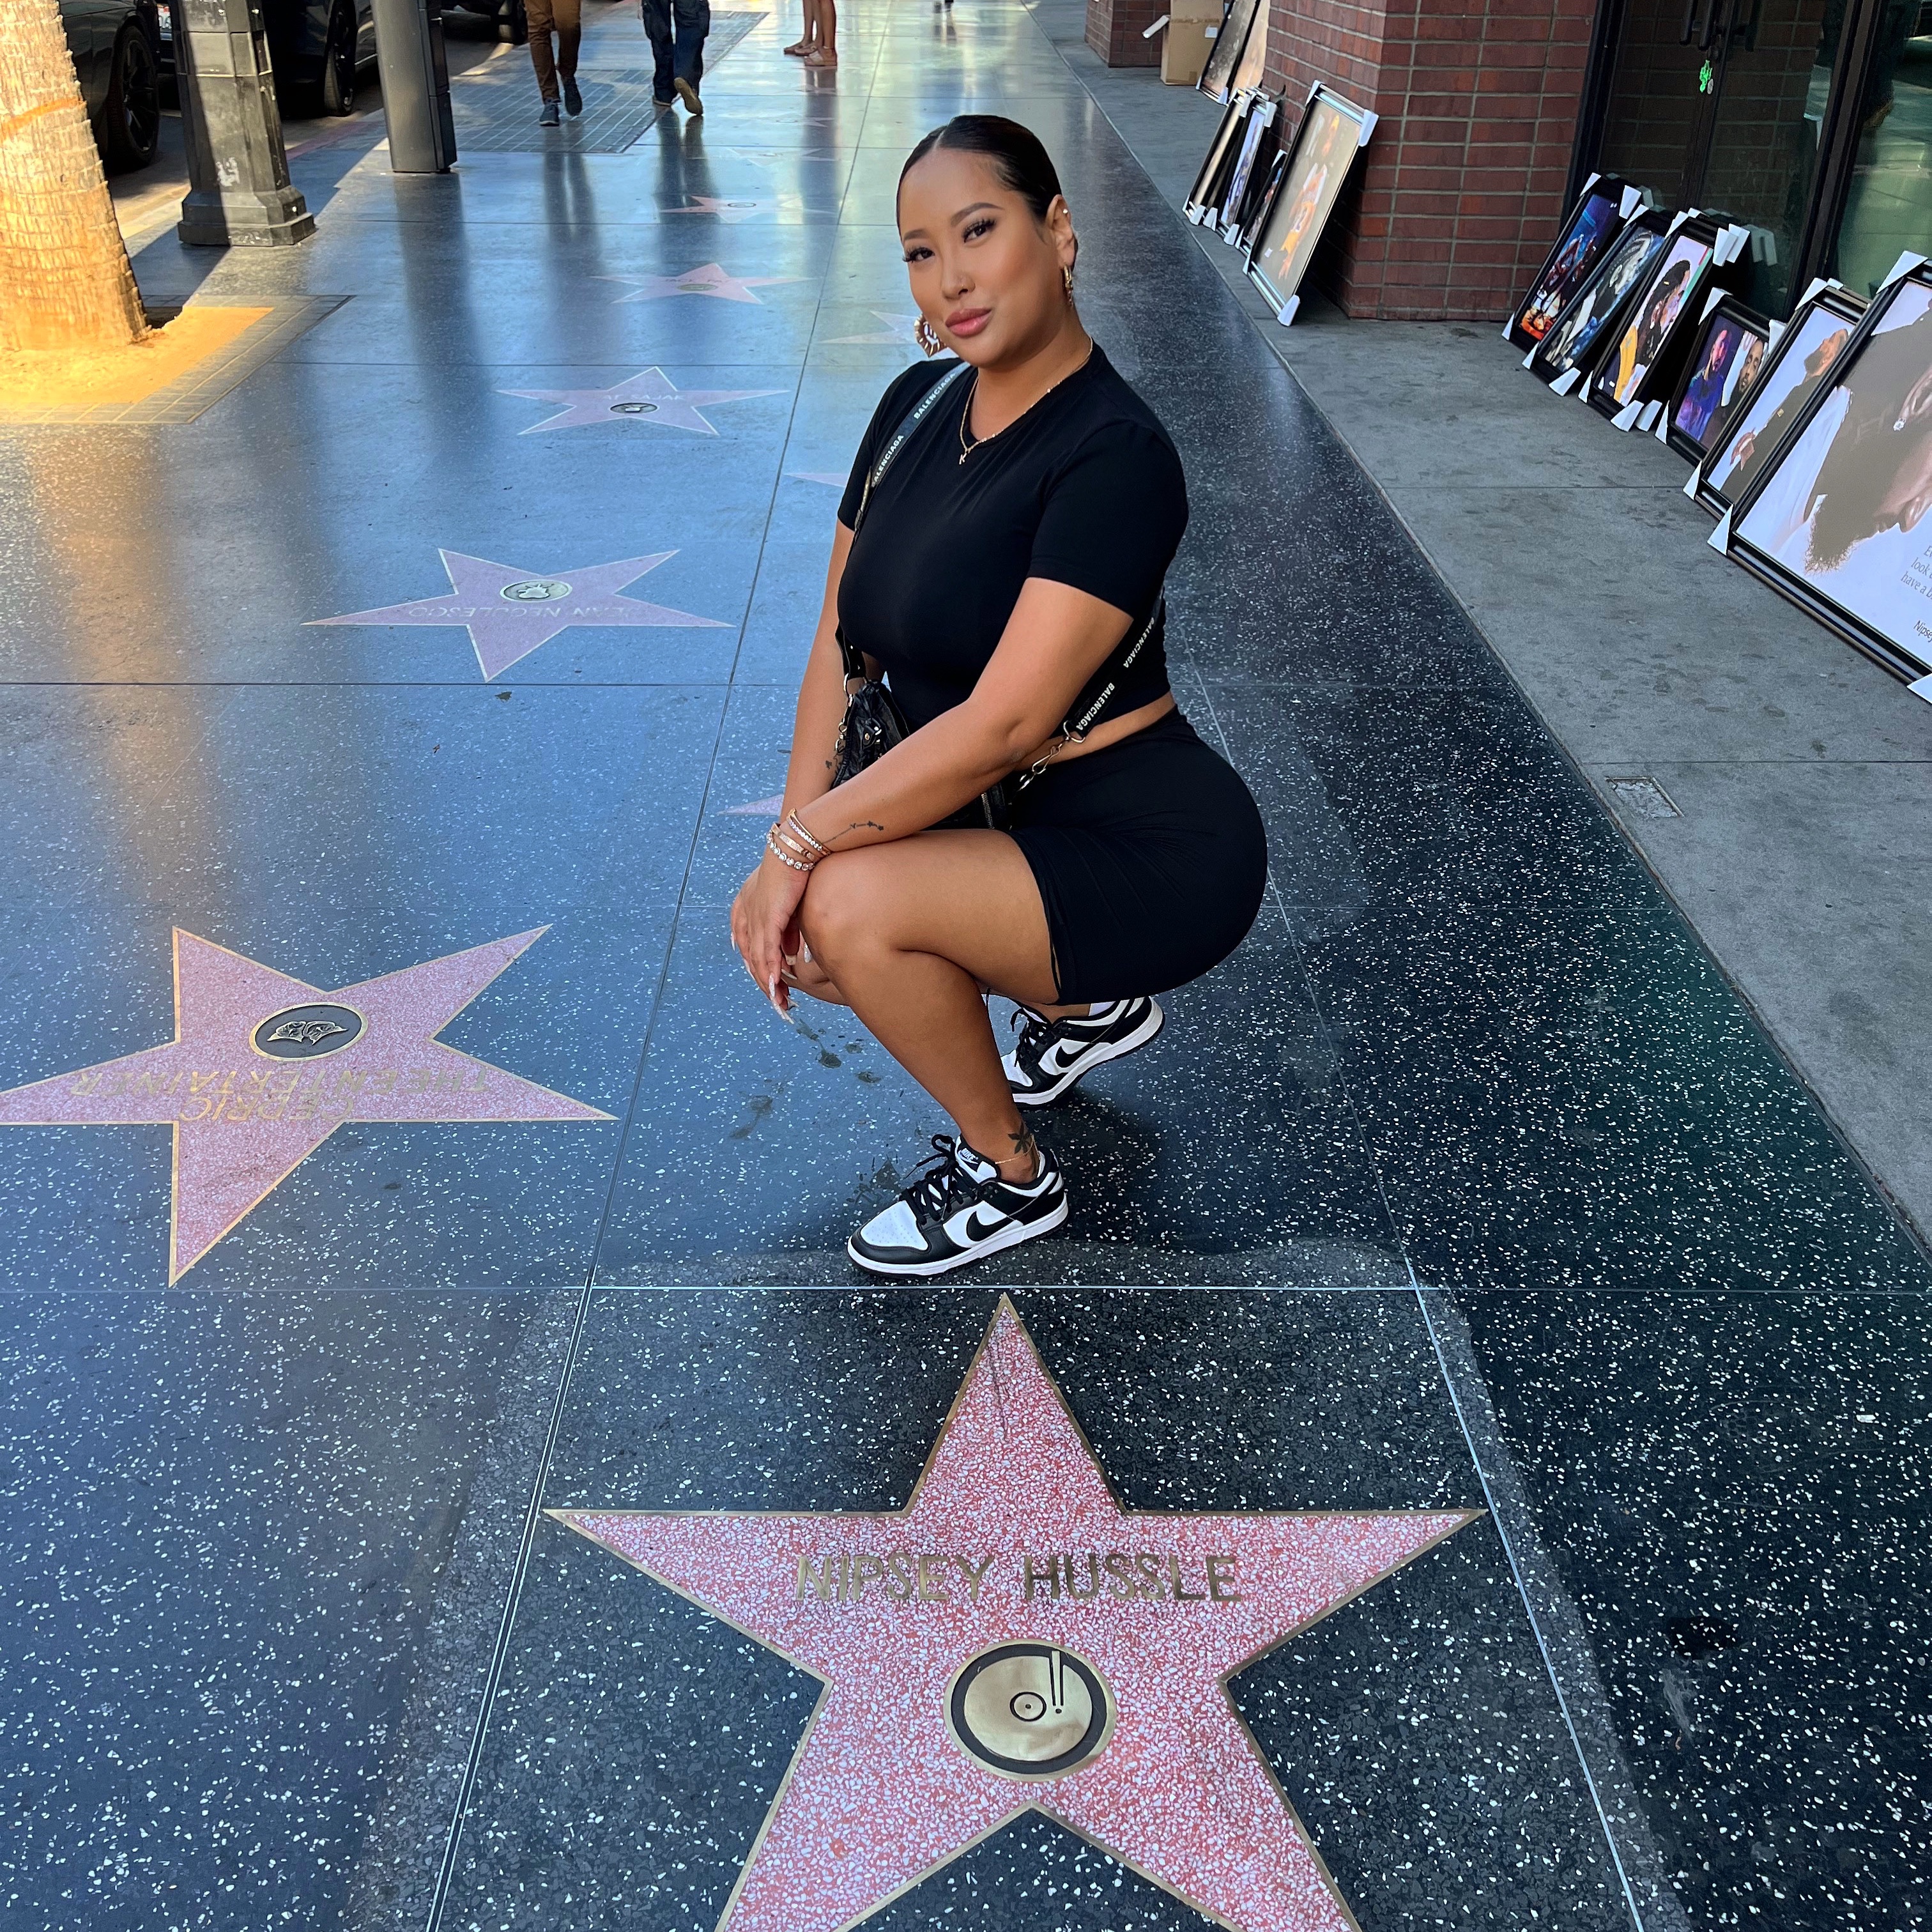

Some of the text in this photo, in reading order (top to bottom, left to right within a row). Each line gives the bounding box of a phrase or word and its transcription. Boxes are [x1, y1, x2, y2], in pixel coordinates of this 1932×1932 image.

[913, 373, 956, 420] BALENCIAGA
[1911, 557, 1930, 576] look
[1901, 571, 1920, 590] have
[1920, 586, 1927, 594] a
[1123, 617, 1154, 668] BALENCIAGA
[1076, 682, 1115, 731] BALENCIAGA
[70, 1067, 489, 1097] THE ENTERTAINER
[178, 1096, 354, 1123] CEDRIC
[960, 1147, 976, 1160] NIKE
[795, 1552, 1241, 1602] NIPSEY HUSSLE
